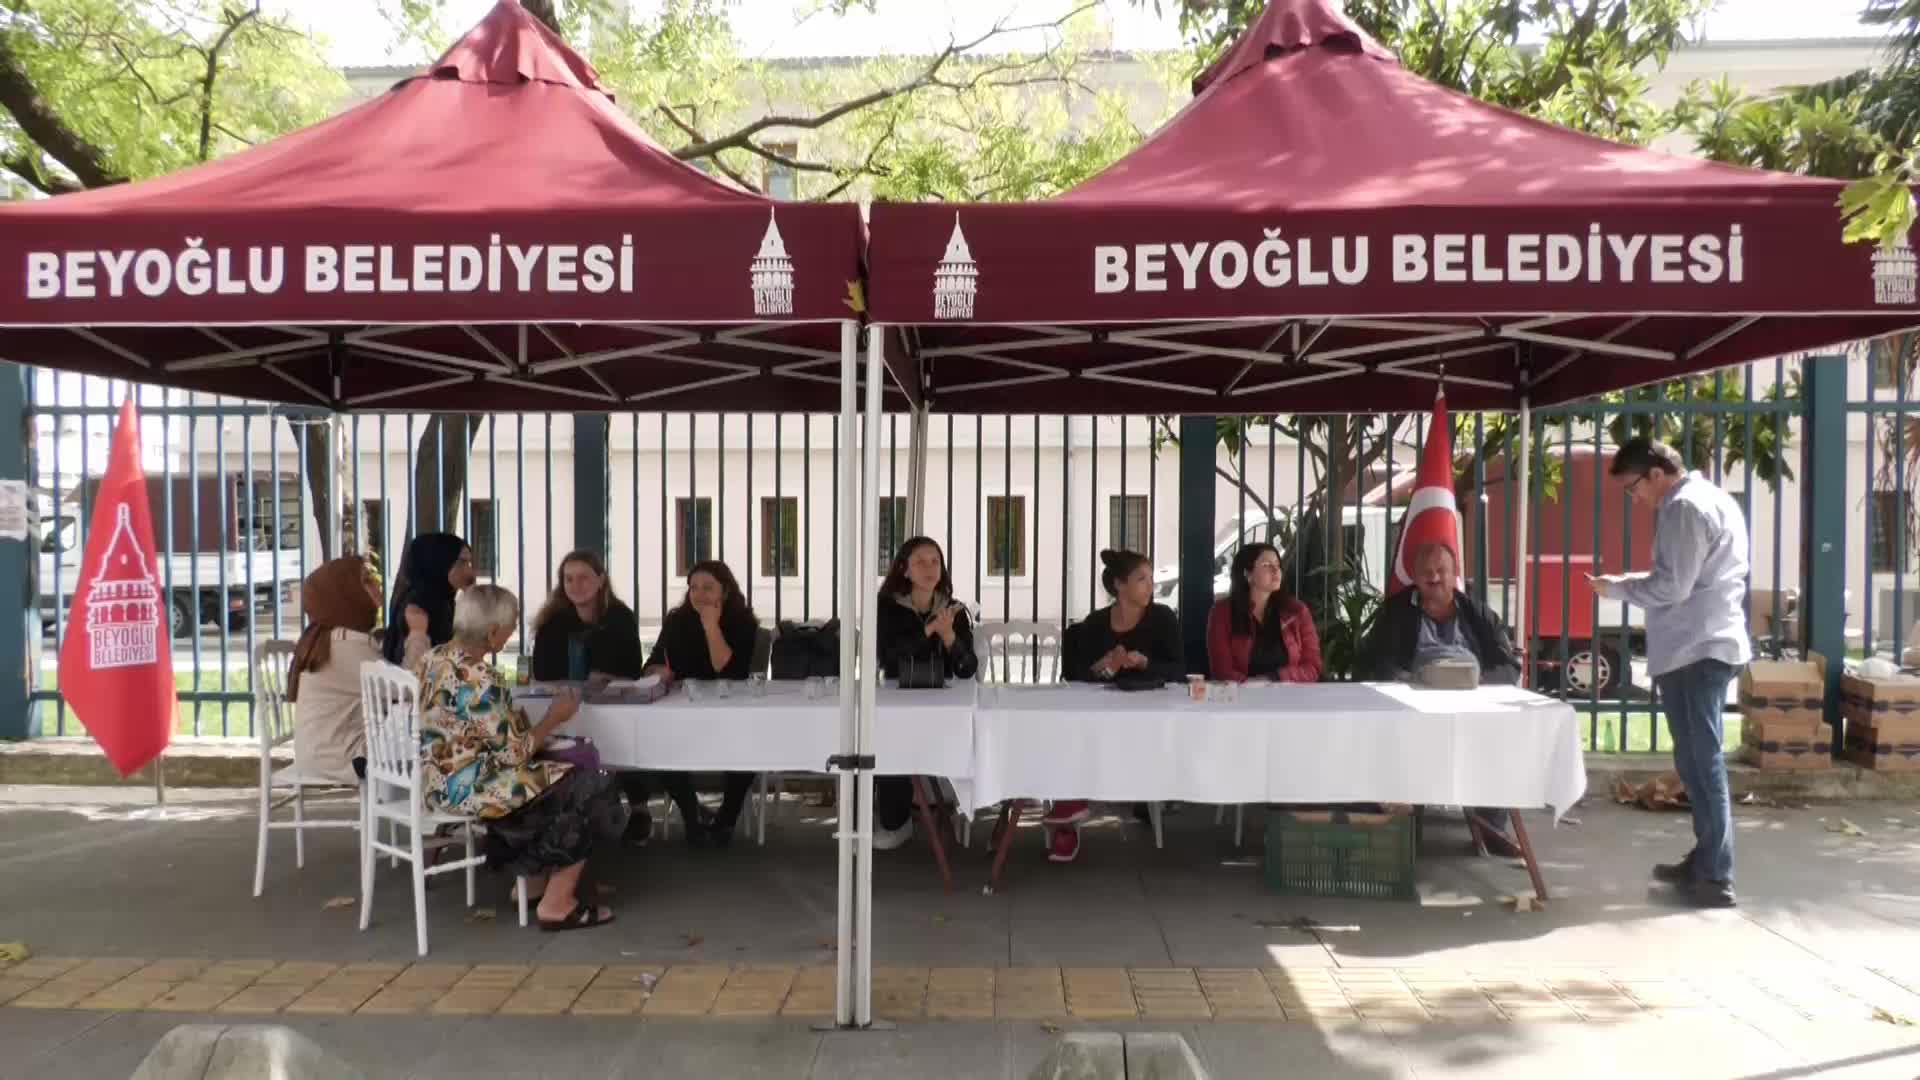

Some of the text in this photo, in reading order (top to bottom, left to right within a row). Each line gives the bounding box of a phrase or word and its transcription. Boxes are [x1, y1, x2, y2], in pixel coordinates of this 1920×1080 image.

[27, 233, 634, 299] BEYOĞLU BELEDİYESİ
[1094, 223, 1743, 293] BEYOĞLU BELEDİYESİ
